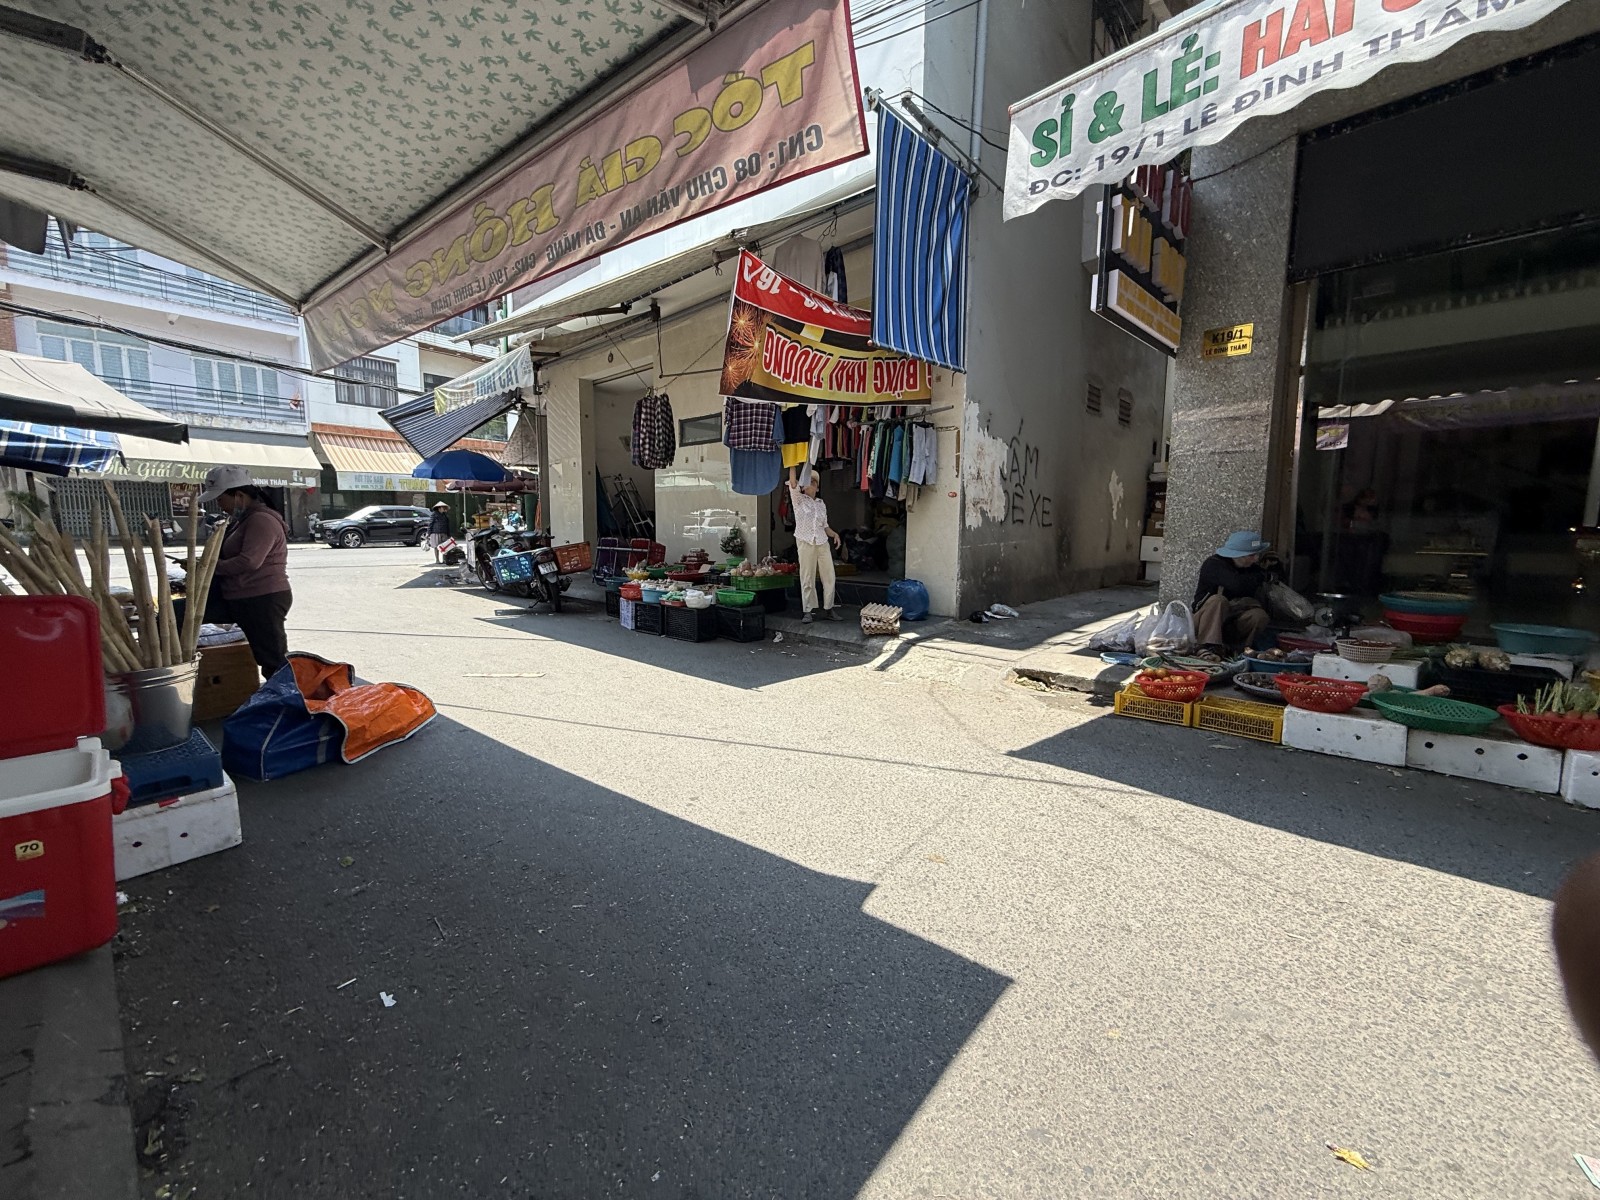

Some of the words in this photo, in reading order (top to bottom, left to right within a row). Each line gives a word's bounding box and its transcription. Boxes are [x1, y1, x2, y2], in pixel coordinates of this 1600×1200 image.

[1029, 93, 1076, 168] SỈ
[1087, 90, 1124, 144] &
[1140, 33, 1221, 123] LẺ:
[1028, 168, 1082, 196] ĐC:
[1095, 130, 1165, 173] 19/1
[1183, 102, 1218, 136] LÊ
[1231, 52, 1344, 115] ĐÌNH
[1212, 329, 1243, 343] K19/1
[829, 357, 868, 393] KHAI
[873, 358, 919, 397] BỪNG
[999, 418, 1039, 483] ẤM
[1029, 488, 1053, 528] XE
[20, 843, 39, 853] 70
